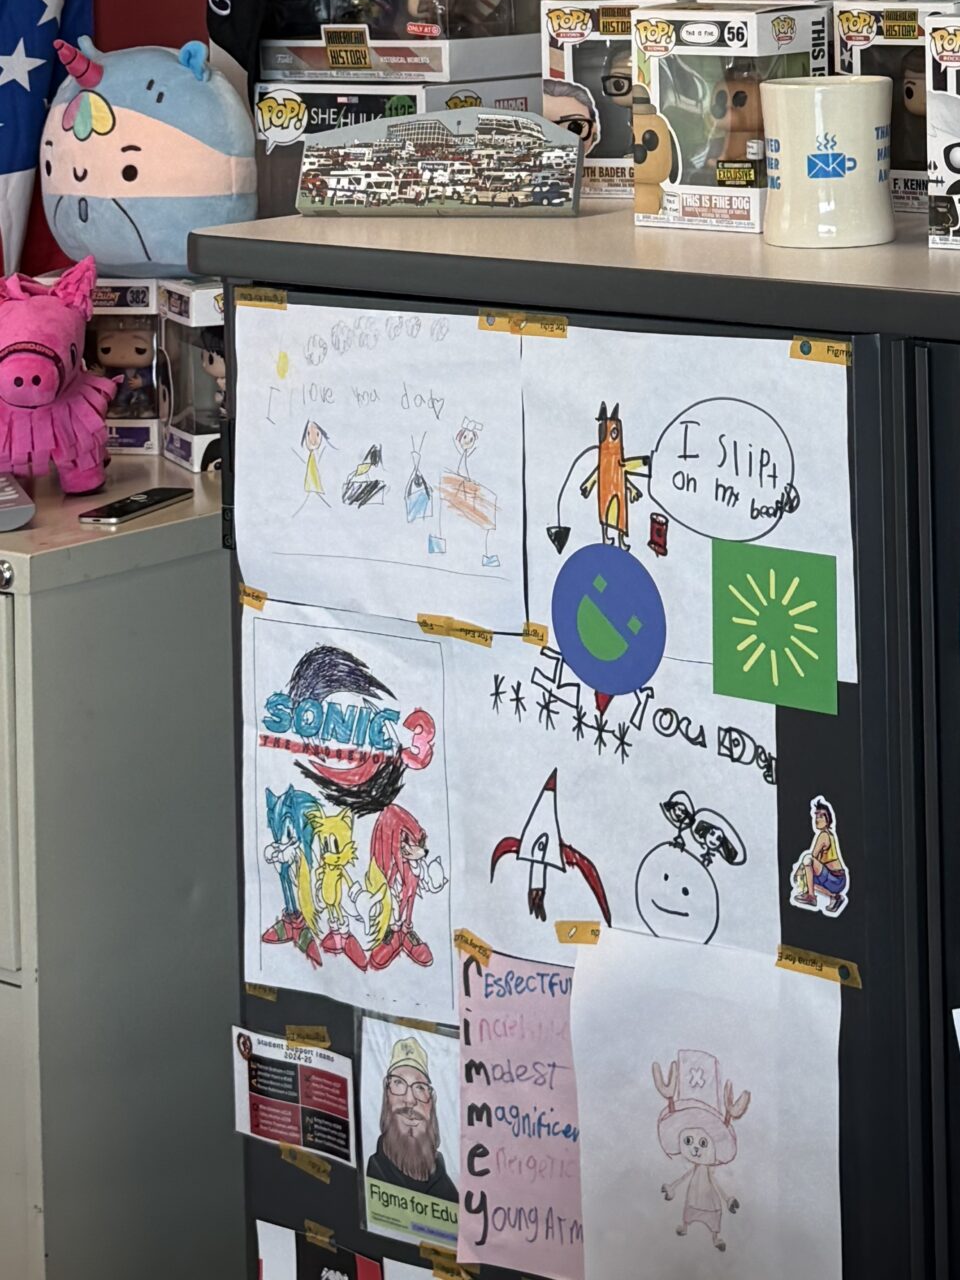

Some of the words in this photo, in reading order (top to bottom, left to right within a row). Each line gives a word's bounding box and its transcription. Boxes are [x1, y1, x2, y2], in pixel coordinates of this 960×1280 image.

[546, 8, 591, 33] POP!
[771, 16, 796, 36] POP!
[837, 10, 875, 36] POP!
[886, 24, 917, 38] HISTORY
[635, 20, 673, 45] POP!
[726, 26, 745, 42] 56
[811, 17, 825, 61] THIS
[330, 49, 368, 66] HISTORY
[256, 96, 307, 131] POP!
[599, 167, 627, 178] BADER
[719, 171, 753, 181] EXCLUSIVE
[904, 178, 928, 191] KENN
[682, 195, 699, 207] THIS
[702, 195, 709, 207] IS
[711, 195, 730, 208] FINE
[732, 197, 750, 210] DOG
[129, 290, 147, 304] 382
[678, 420, 700, 461] I
[672, 471, 697, 493] on
[262, 691, 401, 750] SONIC
[402, 706, 436, 771] 3
[262, 734, 291, 750] THE
[370, 1183, 408, 1210] Figma
[411, 1198, 429, 1216] for
[431, 1202, 458, 1224] Edu
